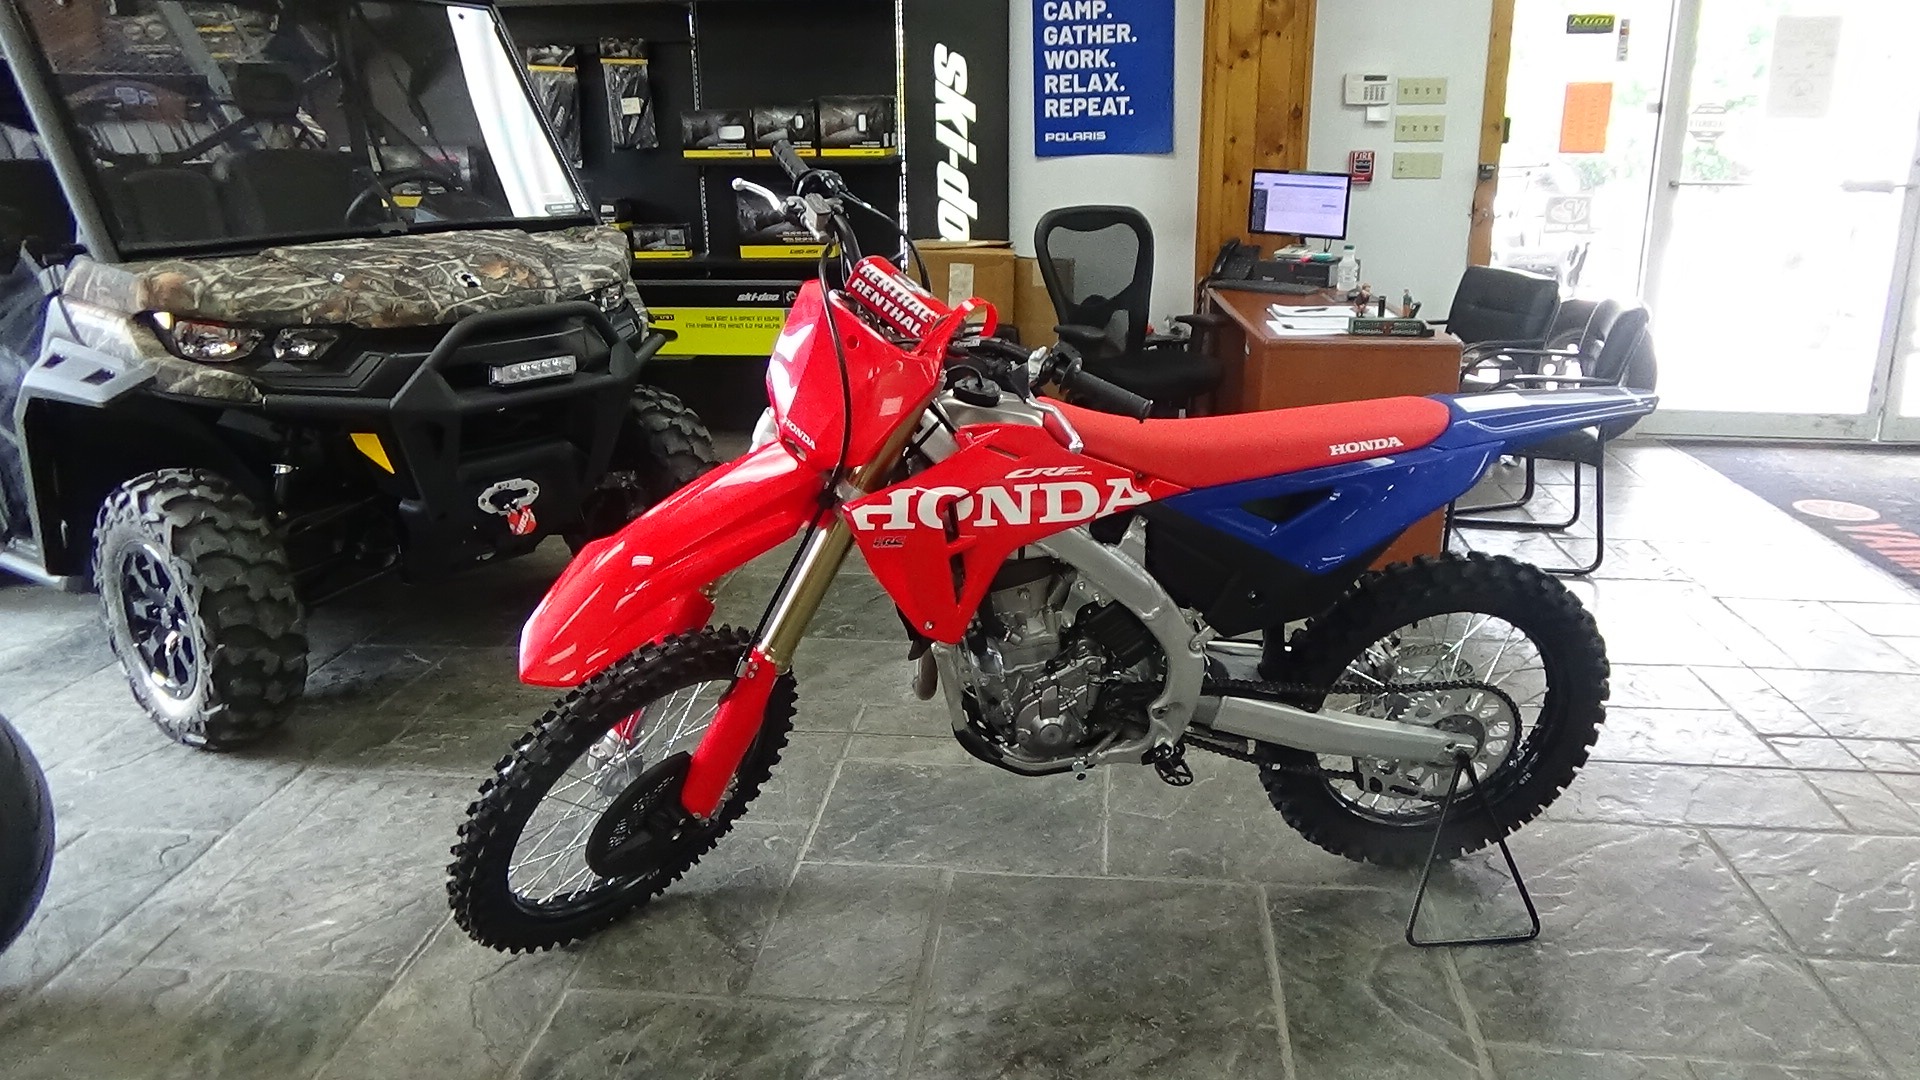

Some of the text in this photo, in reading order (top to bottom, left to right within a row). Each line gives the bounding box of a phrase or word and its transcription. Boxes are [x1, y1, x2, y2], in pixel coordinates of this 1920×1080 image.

[1043, 1, 1113, 21] CAMP.
[1043, 23, 1138, 46] GATHER.
[1044, 48, 1116, 70] WORK.
[1044, 72, 1126, 94] RELAX.
[1044, 96, 1135, 118] REPEAT.
[934, 43, 978, 242] ski-do
[1044, 131, 1107, 142] POLARIS
[1354, 152, 1373, 160] FIRE
[858, 263, 930, 324] RENTHAL
[851, 277, 922, 338] RENTHAL
[781, 418, 816, 450] HONDA
[1328, 436, 1405, 456] HONDA
[1004, 465, 1085, 479] CRF
[850, 477, 1152, 531] HONDA
